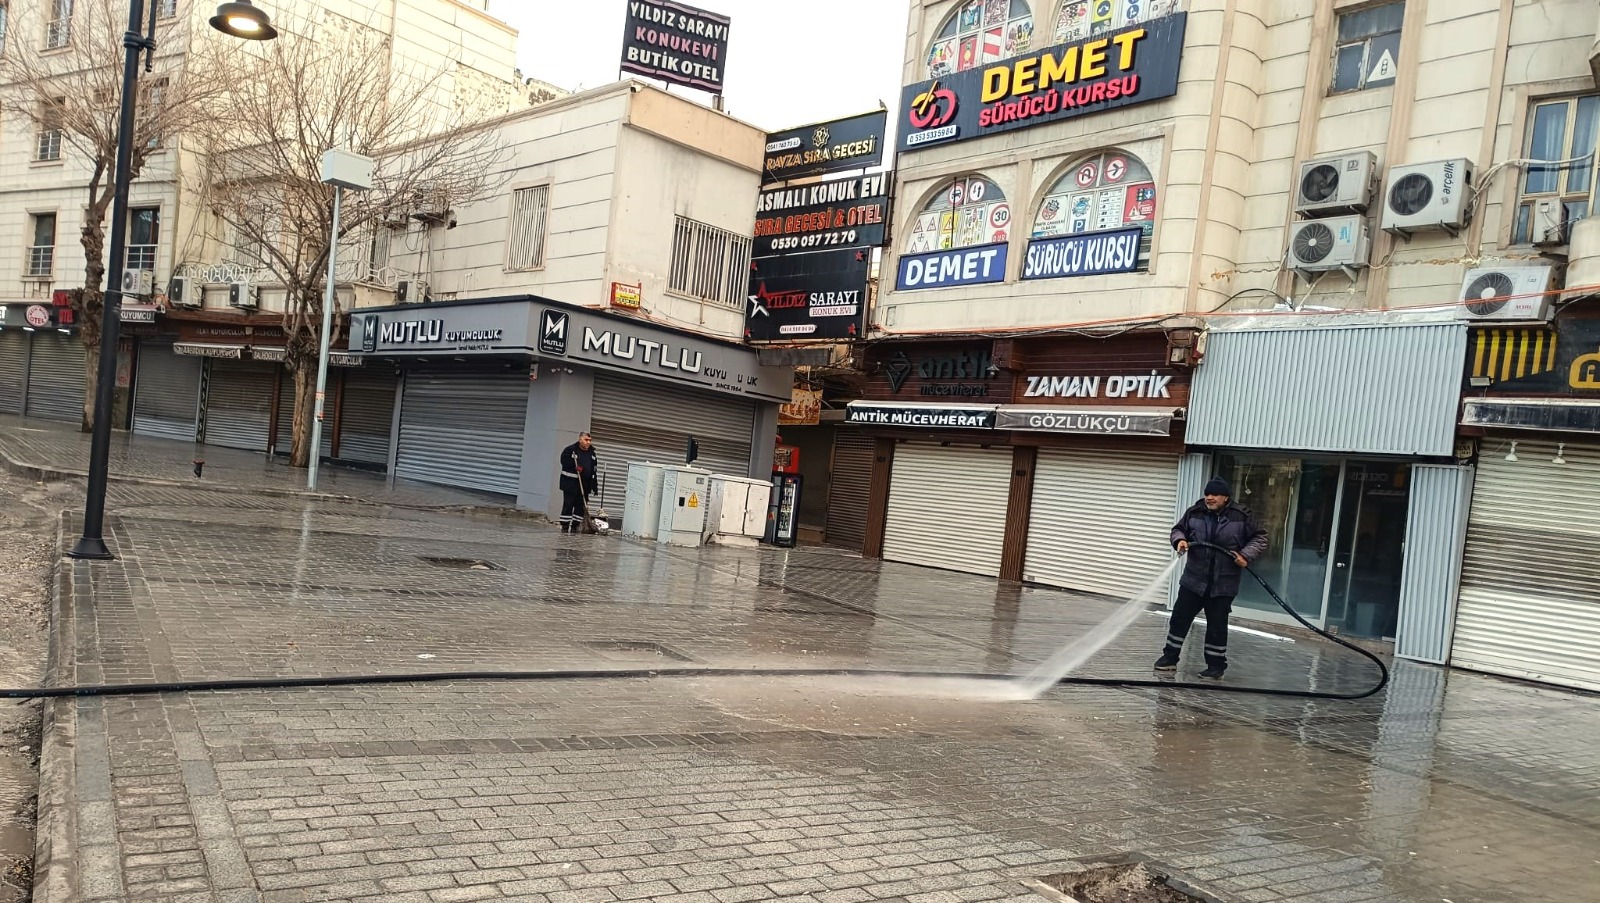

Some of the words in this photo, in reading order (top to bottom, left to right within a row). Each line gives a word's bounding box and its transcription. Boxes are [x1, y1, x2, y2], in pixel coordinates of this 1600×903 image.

[631, 2, 674, 27] YILDIZ
[678, 17, 728, 41] SARAYI
[627, 46, 678, 72] BUTİK
[681, 60, 720, 82] OTEL
[981, 29, 1146, 104] DEMET
[979, 87, 1060, 127] SÜRÜCÜ
[1062, 74, 1139, 109] KURSU
[766, 153, 802, 170] RAVZA
[832, 135, 875, 159] GECESİ
[1443, 162, 1455, 195] arçelik
[757, 187, 806, 212] ASMALI
[810, 180, 855, 205] KONUK
[754, 217, 781, 236] SIRA
[785, 207, 831, 234] GECESİ
[834, 209, 845, 227] &
[848, 204, 882, 226] OTEL
[994, 210, 1007, 222] 30
[771, 237, 798, 250] 0530
[800, 234, 822, 248] 097
[824, 232, 838, 245] 72
[841, 230, 855, 243] 70
[1025, 239, 1083, 277] SÜRÜCÜ
[1084, 234, 1138, 271] KURSU
[905, 250, 997, 286] DEMET
[767, 293, 806, 309] YILDIZ
[809, 290, 859, 307] SARAYI
[812, 307, 838, 316] KONUK
[380, 320, 441, 342] MUTLU
[445, 329, 502, 341] KUYUMCULUK
[543, 339, 564, 347] MUTLU
[583, 327, 702, 373] MUTLU
[1023, 375, 1100, 398] ZAMAN
[1105, 370, 1172, 398] OPTİK
[851, 409, 889, 423] ANTİK
[891, 410, 986, 427] MÜCEVHERAT
[1029, 413, 1130, 432] GÖZLÜKÇÜ
